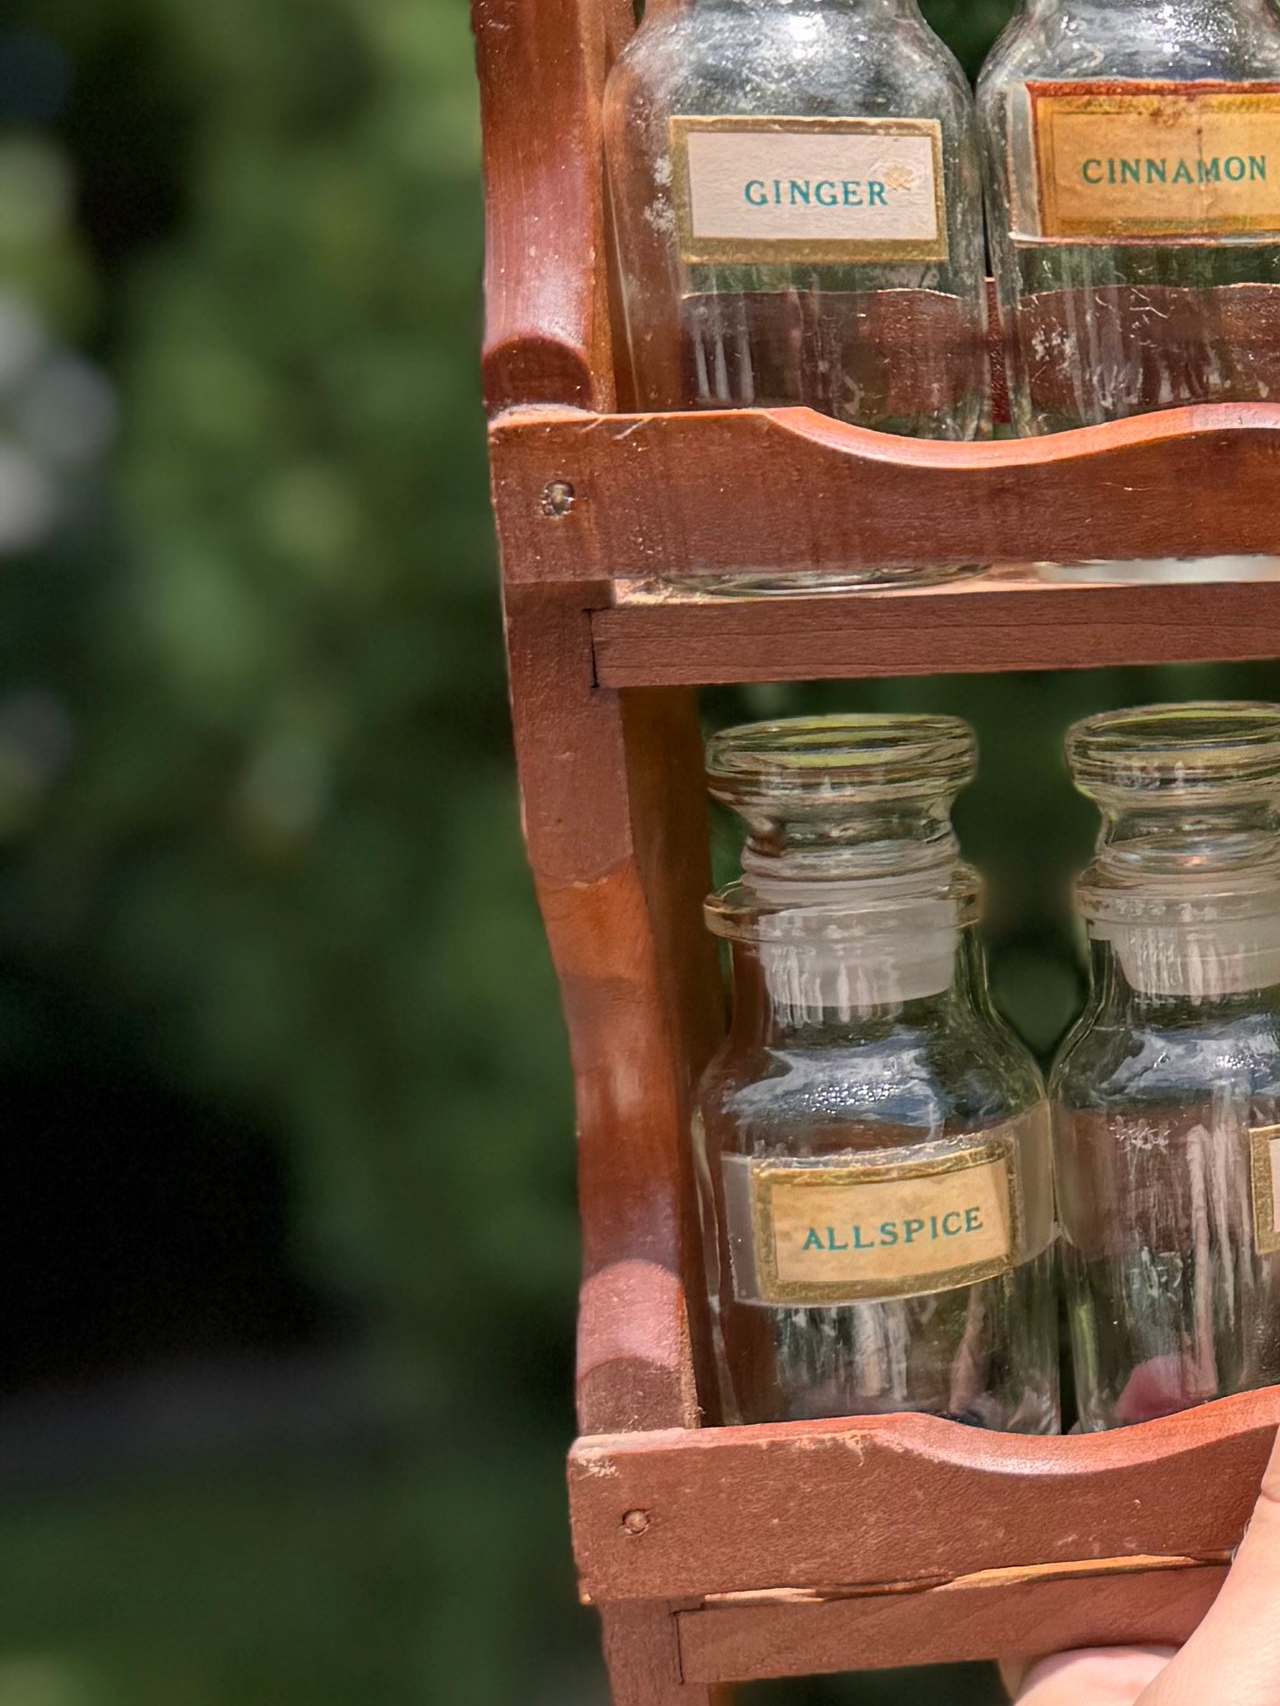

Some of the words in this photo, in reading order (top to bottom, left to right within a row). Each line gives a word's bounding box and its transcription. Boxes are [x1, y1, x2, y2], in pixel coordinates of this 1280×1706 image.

[1082, 155, 1268, 184] CINNAMON
[745, 180, 888, 208] GINGER
[802, 1205, 984, 1252] ALLSPICE
